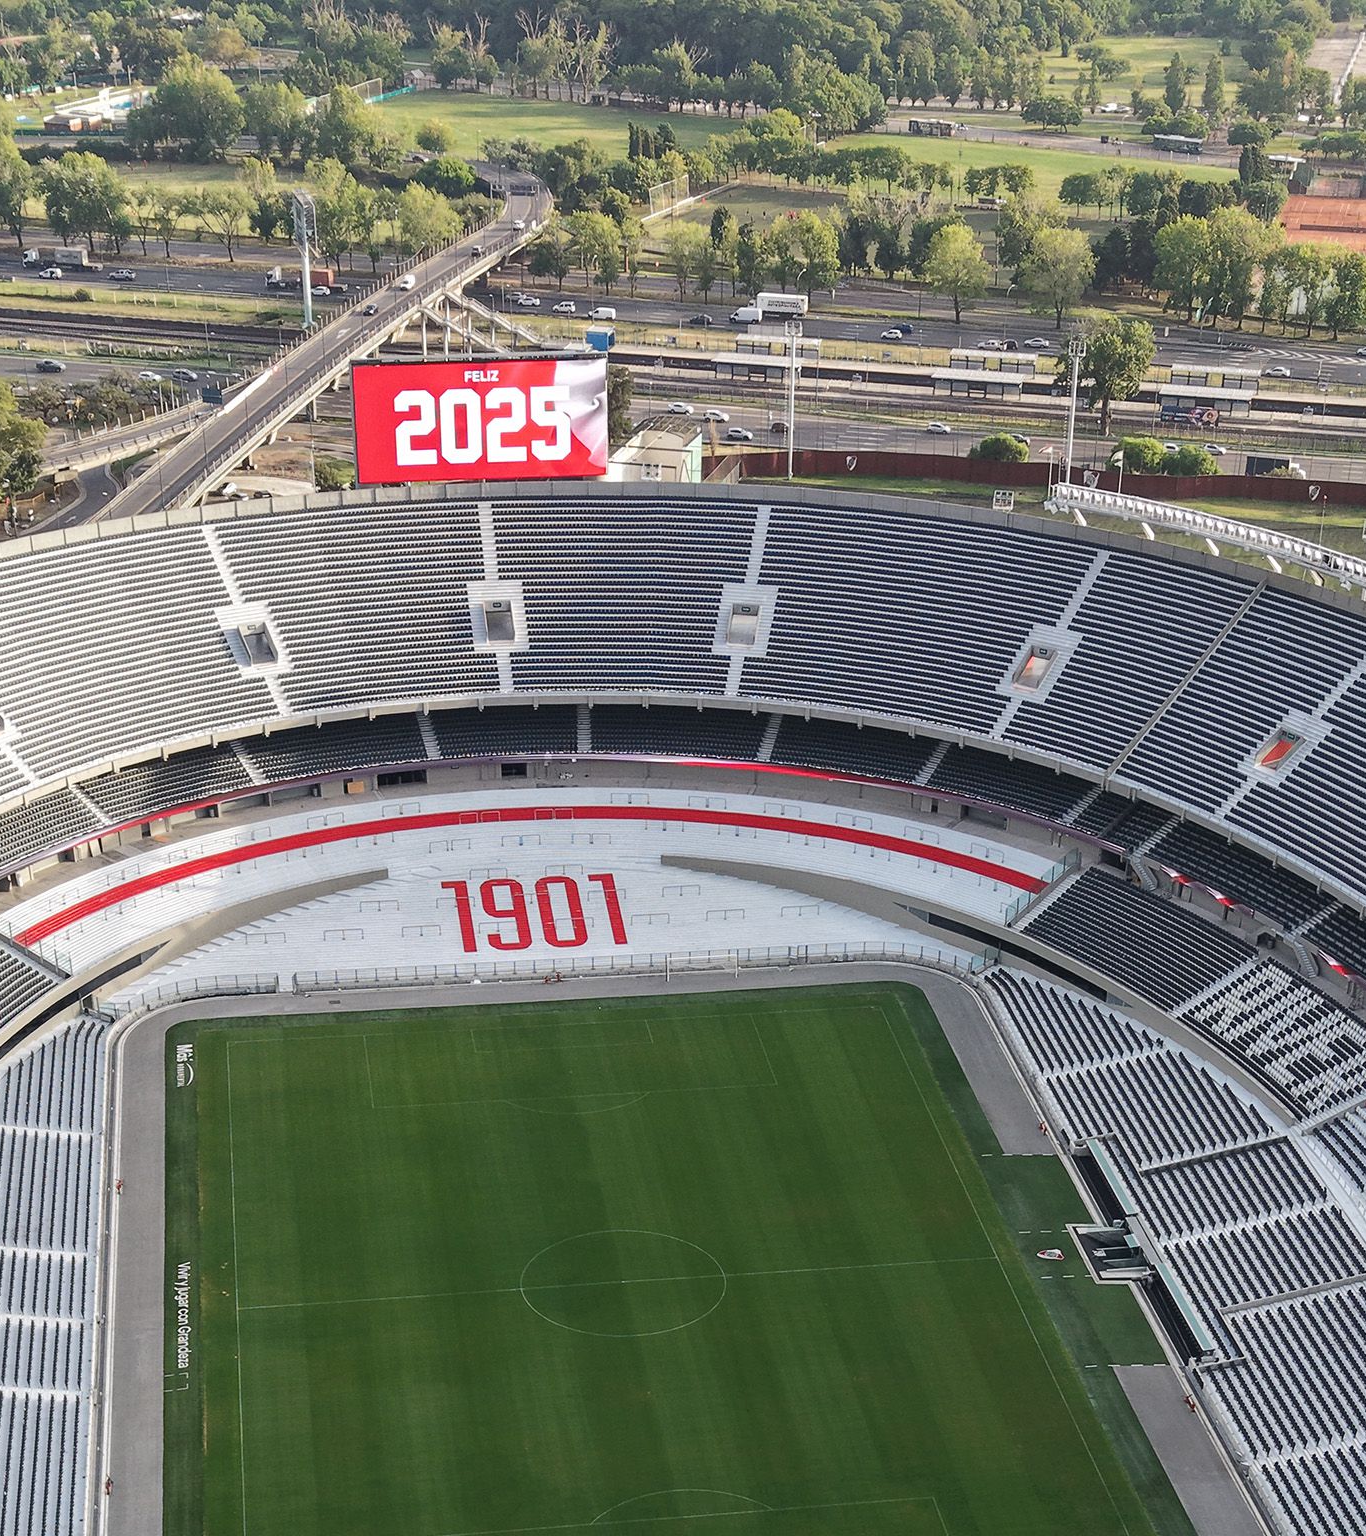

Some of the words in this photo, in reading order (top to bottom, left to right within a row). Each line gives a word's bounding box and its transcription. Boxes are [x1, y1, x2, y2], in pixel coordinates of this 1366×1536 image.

[464, 370, 499, 382] FELIZ
[393, 385, 572, 466] 2025
[441, 873, 628, 952] 1901
[178, 1262, 191, 1280] Vivir
[175, 1287, 191, 1308] jugar
[178, 1309, 189, 1326] con
[178, 1326, 192, 1368] Grandeza
